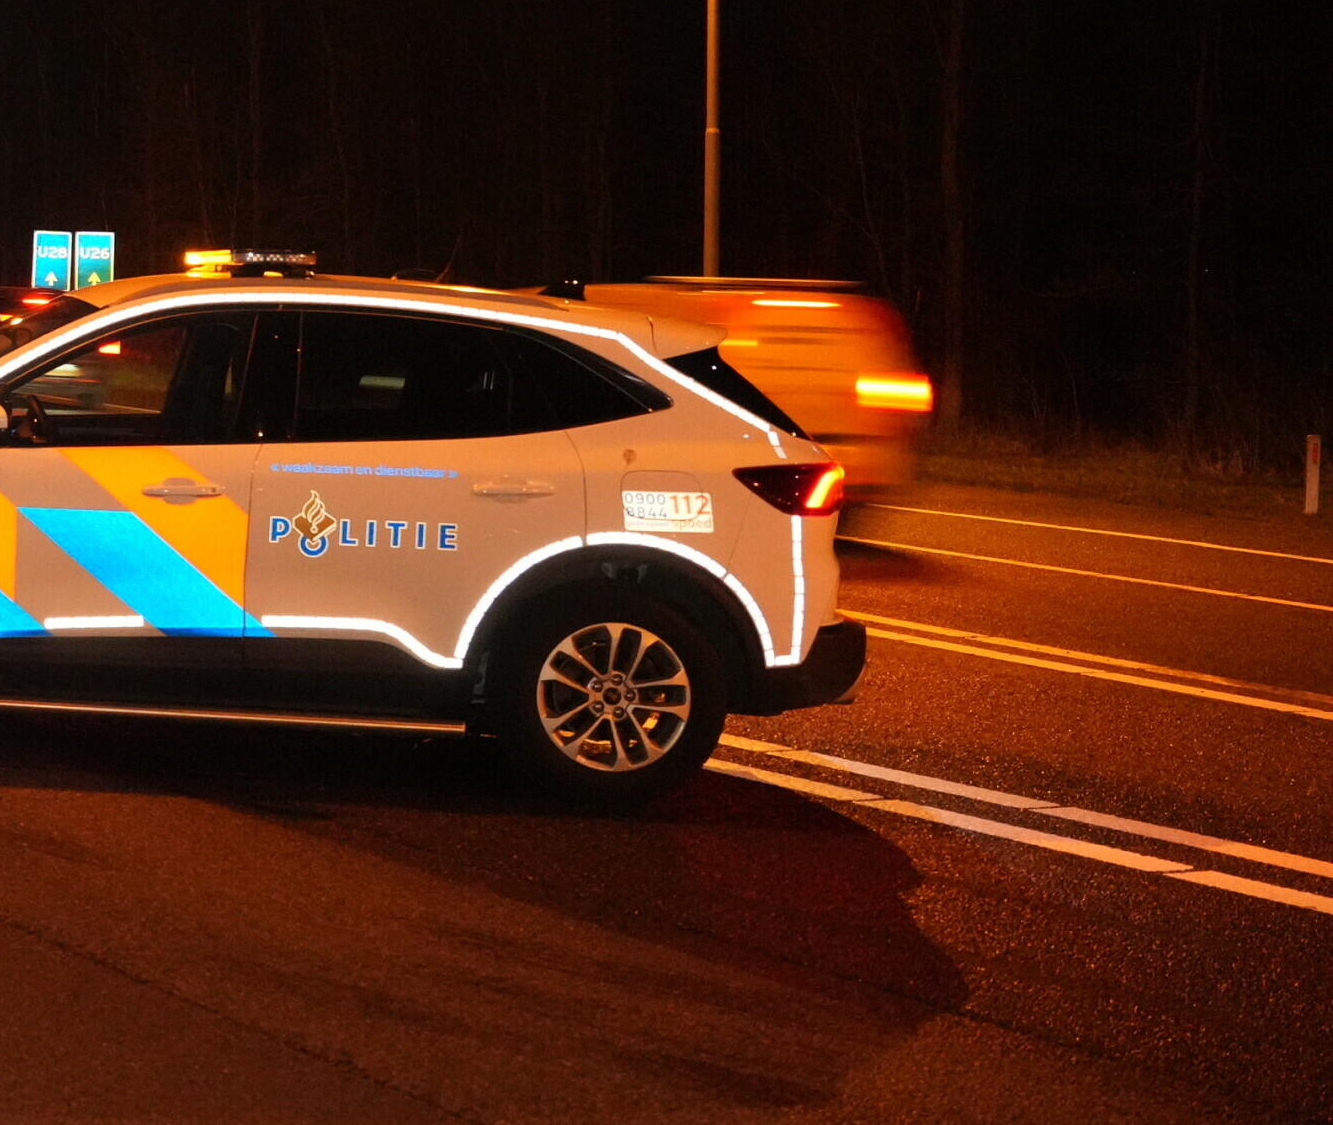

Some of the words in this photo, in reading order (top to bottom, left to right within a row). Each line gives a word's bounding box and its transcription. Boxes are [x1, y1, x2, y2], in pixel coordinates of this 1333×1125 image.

[38, 246, 68, 258] U28
[80, 247, 110, 259] U26
[282, 462, 354, 474] waakzaam
[355, 465, 373, 475] en
[374, 464, 445, 478] dienstbaar
[624, 492, 666, 505] 0900
[669, 494, 710, 515] 112
[626, 506, 667, 518] 8844
[269, 515, 458, 558] POLITIE
